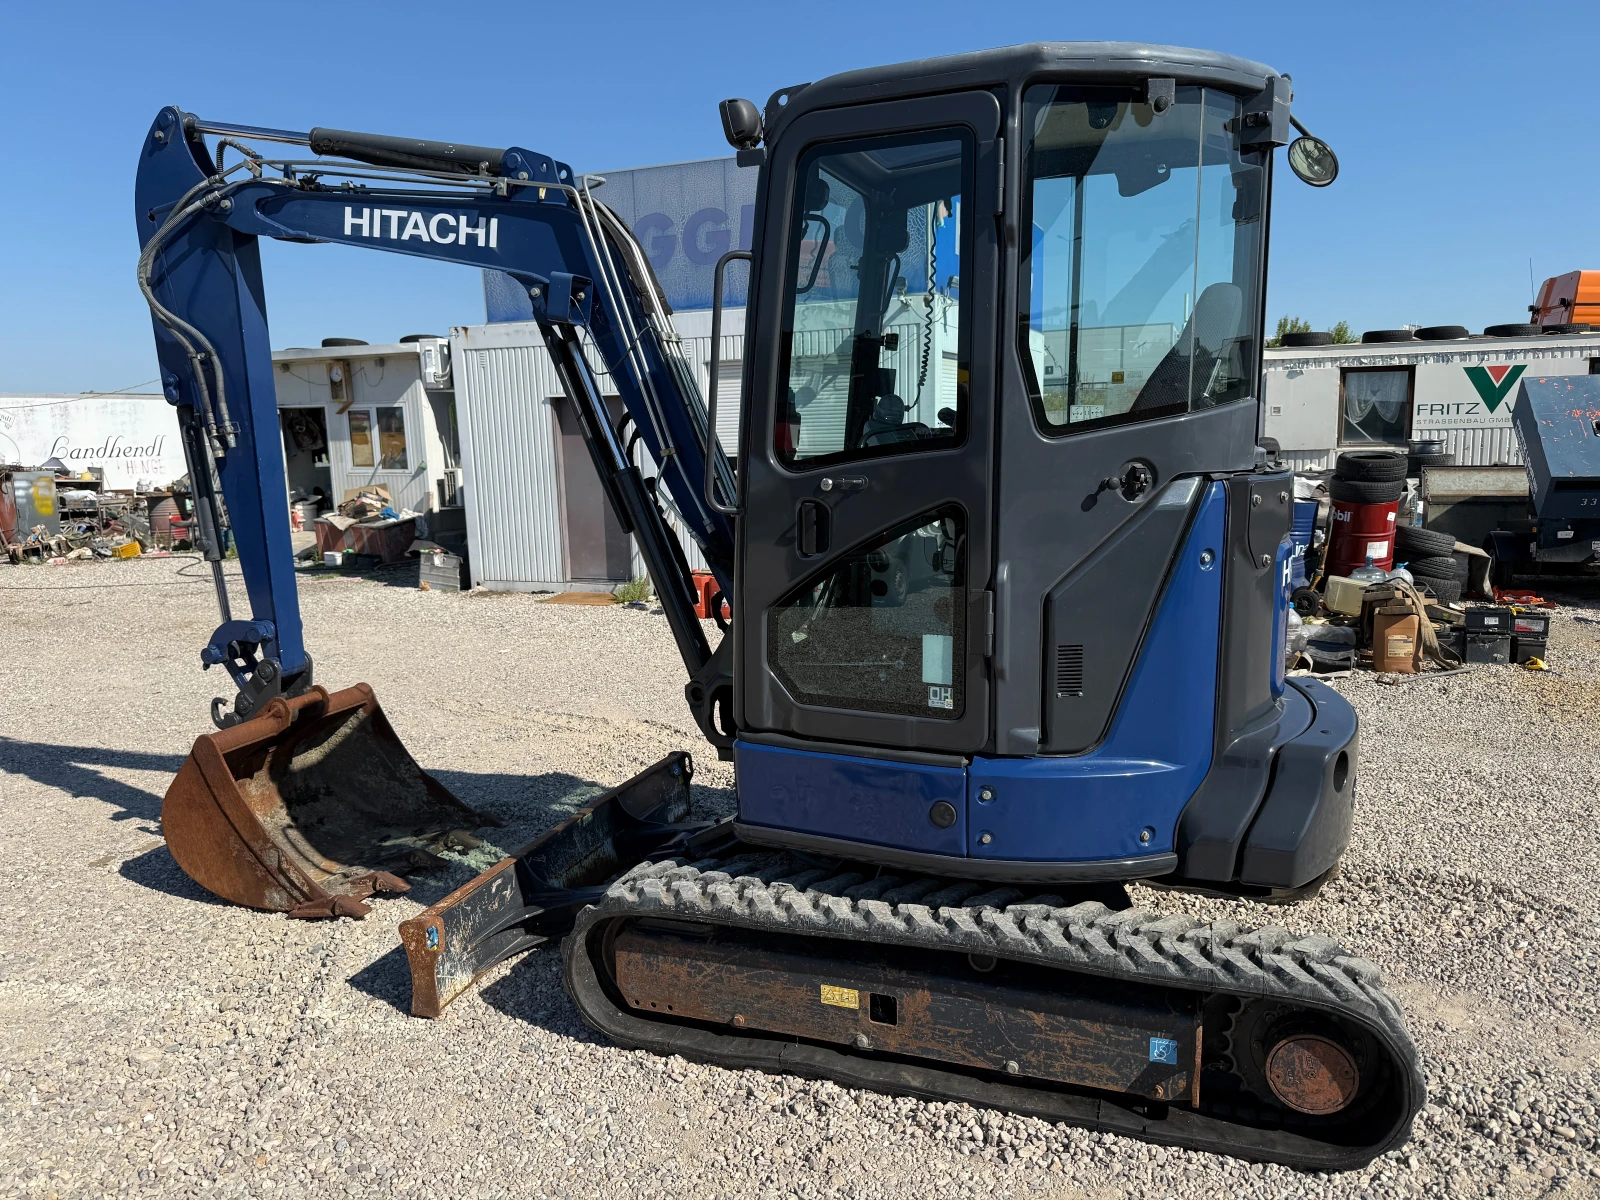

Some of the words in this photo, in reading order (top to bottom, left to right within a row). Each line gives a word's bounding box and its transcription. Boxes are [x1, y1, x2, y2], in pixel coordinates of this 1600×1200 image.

[344, 206, 498, 248] HITACHI
[1417, 402, 1480, 416] FRITZ
[48, 434, 166, 460] Landhendl
[1332, 509, 1351, 522] obil
